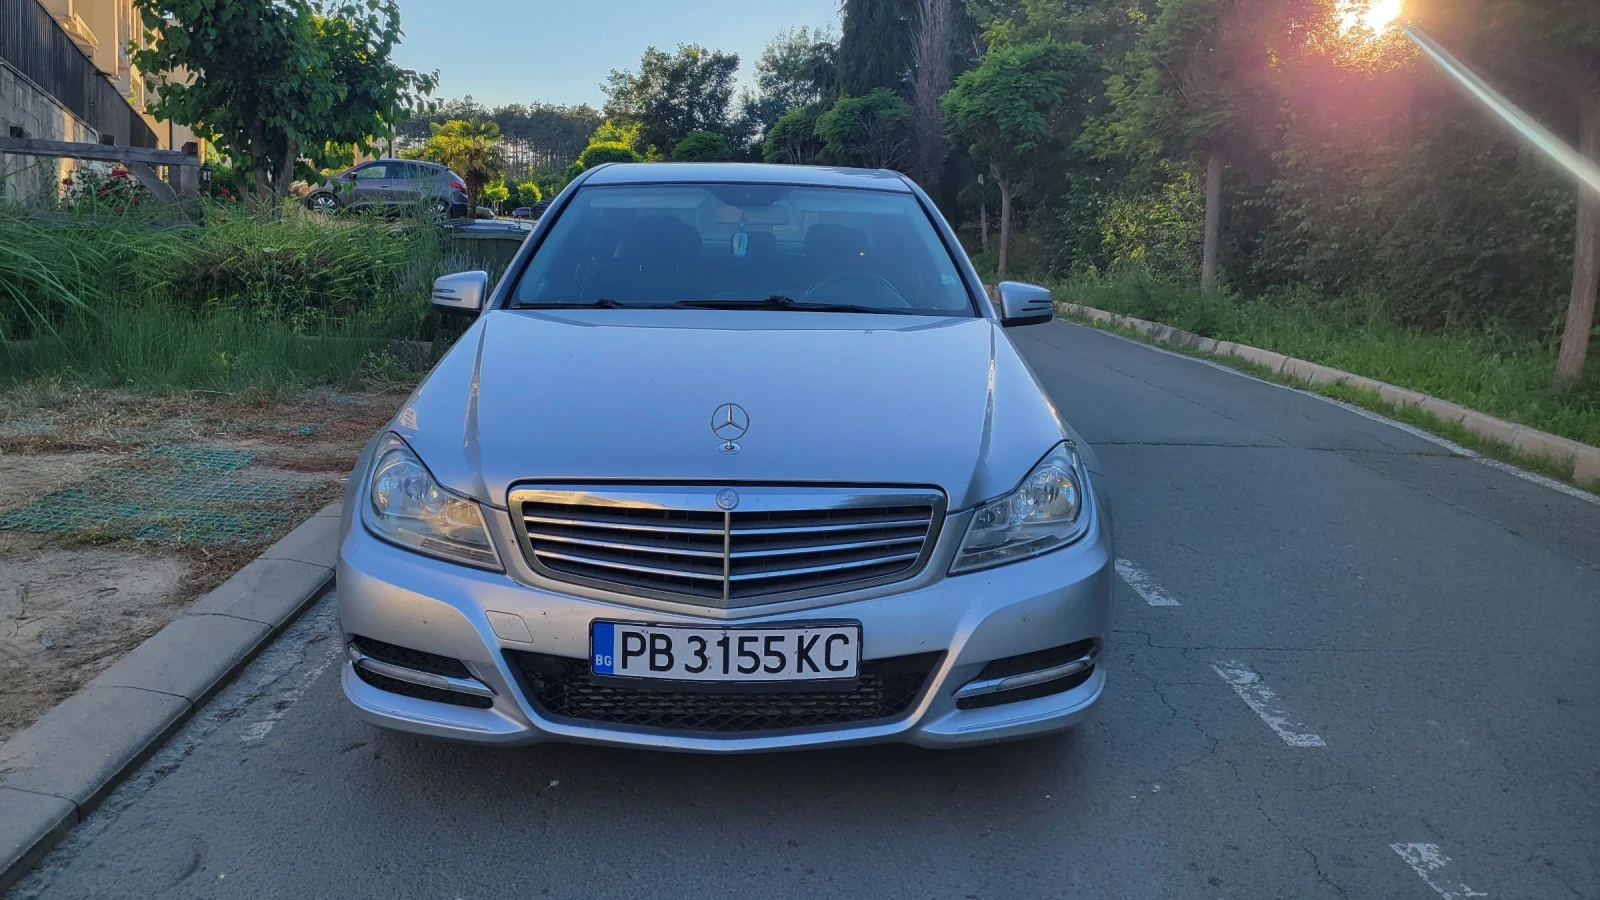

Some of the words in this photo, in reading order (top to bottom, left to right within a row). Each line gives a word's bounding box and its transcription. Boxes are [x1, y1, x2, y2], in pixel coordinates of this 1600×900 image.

[595, 654, 612, 667] BG
[621, 631, 675, 672] PB
[684, 635, 787, 675] 3155
[796, 633, 850, 673] KC
